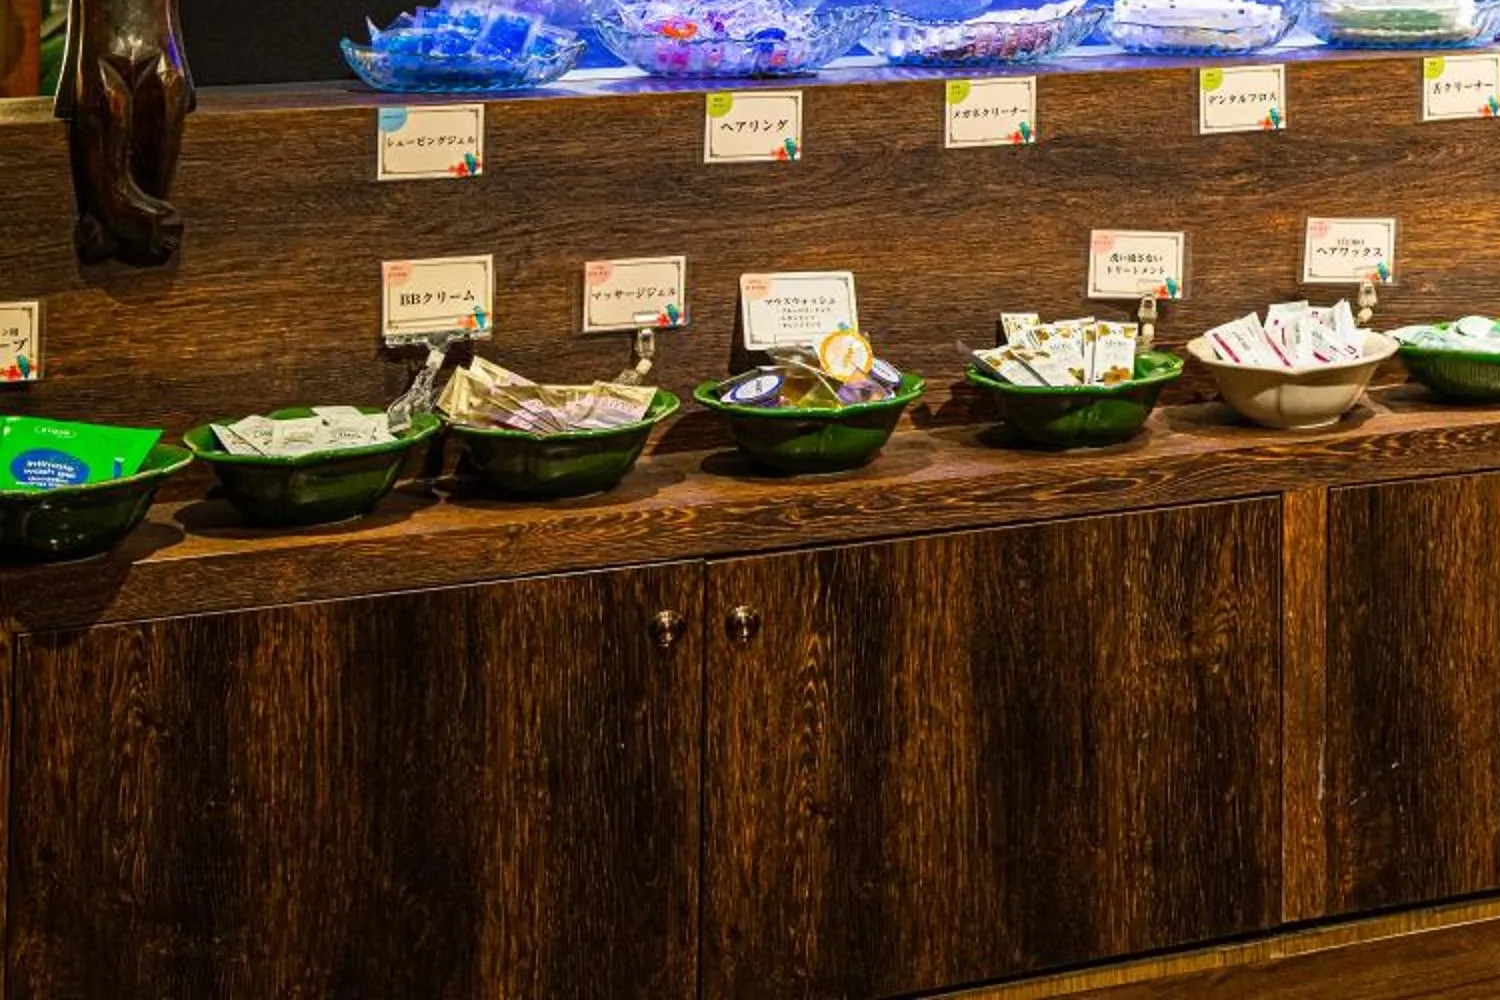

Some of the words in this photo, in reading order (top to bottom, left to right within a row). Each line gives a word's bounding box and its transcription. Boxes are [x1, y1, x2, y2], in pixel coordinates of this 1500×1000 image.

[1207, 93, 1278, 106] デンタルフロス
[952, 107, 1029, 120] メガネクリーナー
[719, 118, 790, 134] ヘアリング
[1316, 247, 1384, 257] ヘアワックス
[1106, 265, 1165, 275] トリートメント
[399, 288, 476, 307] BBクリーム
[591, 287, 676, 301] マッサージジェル
